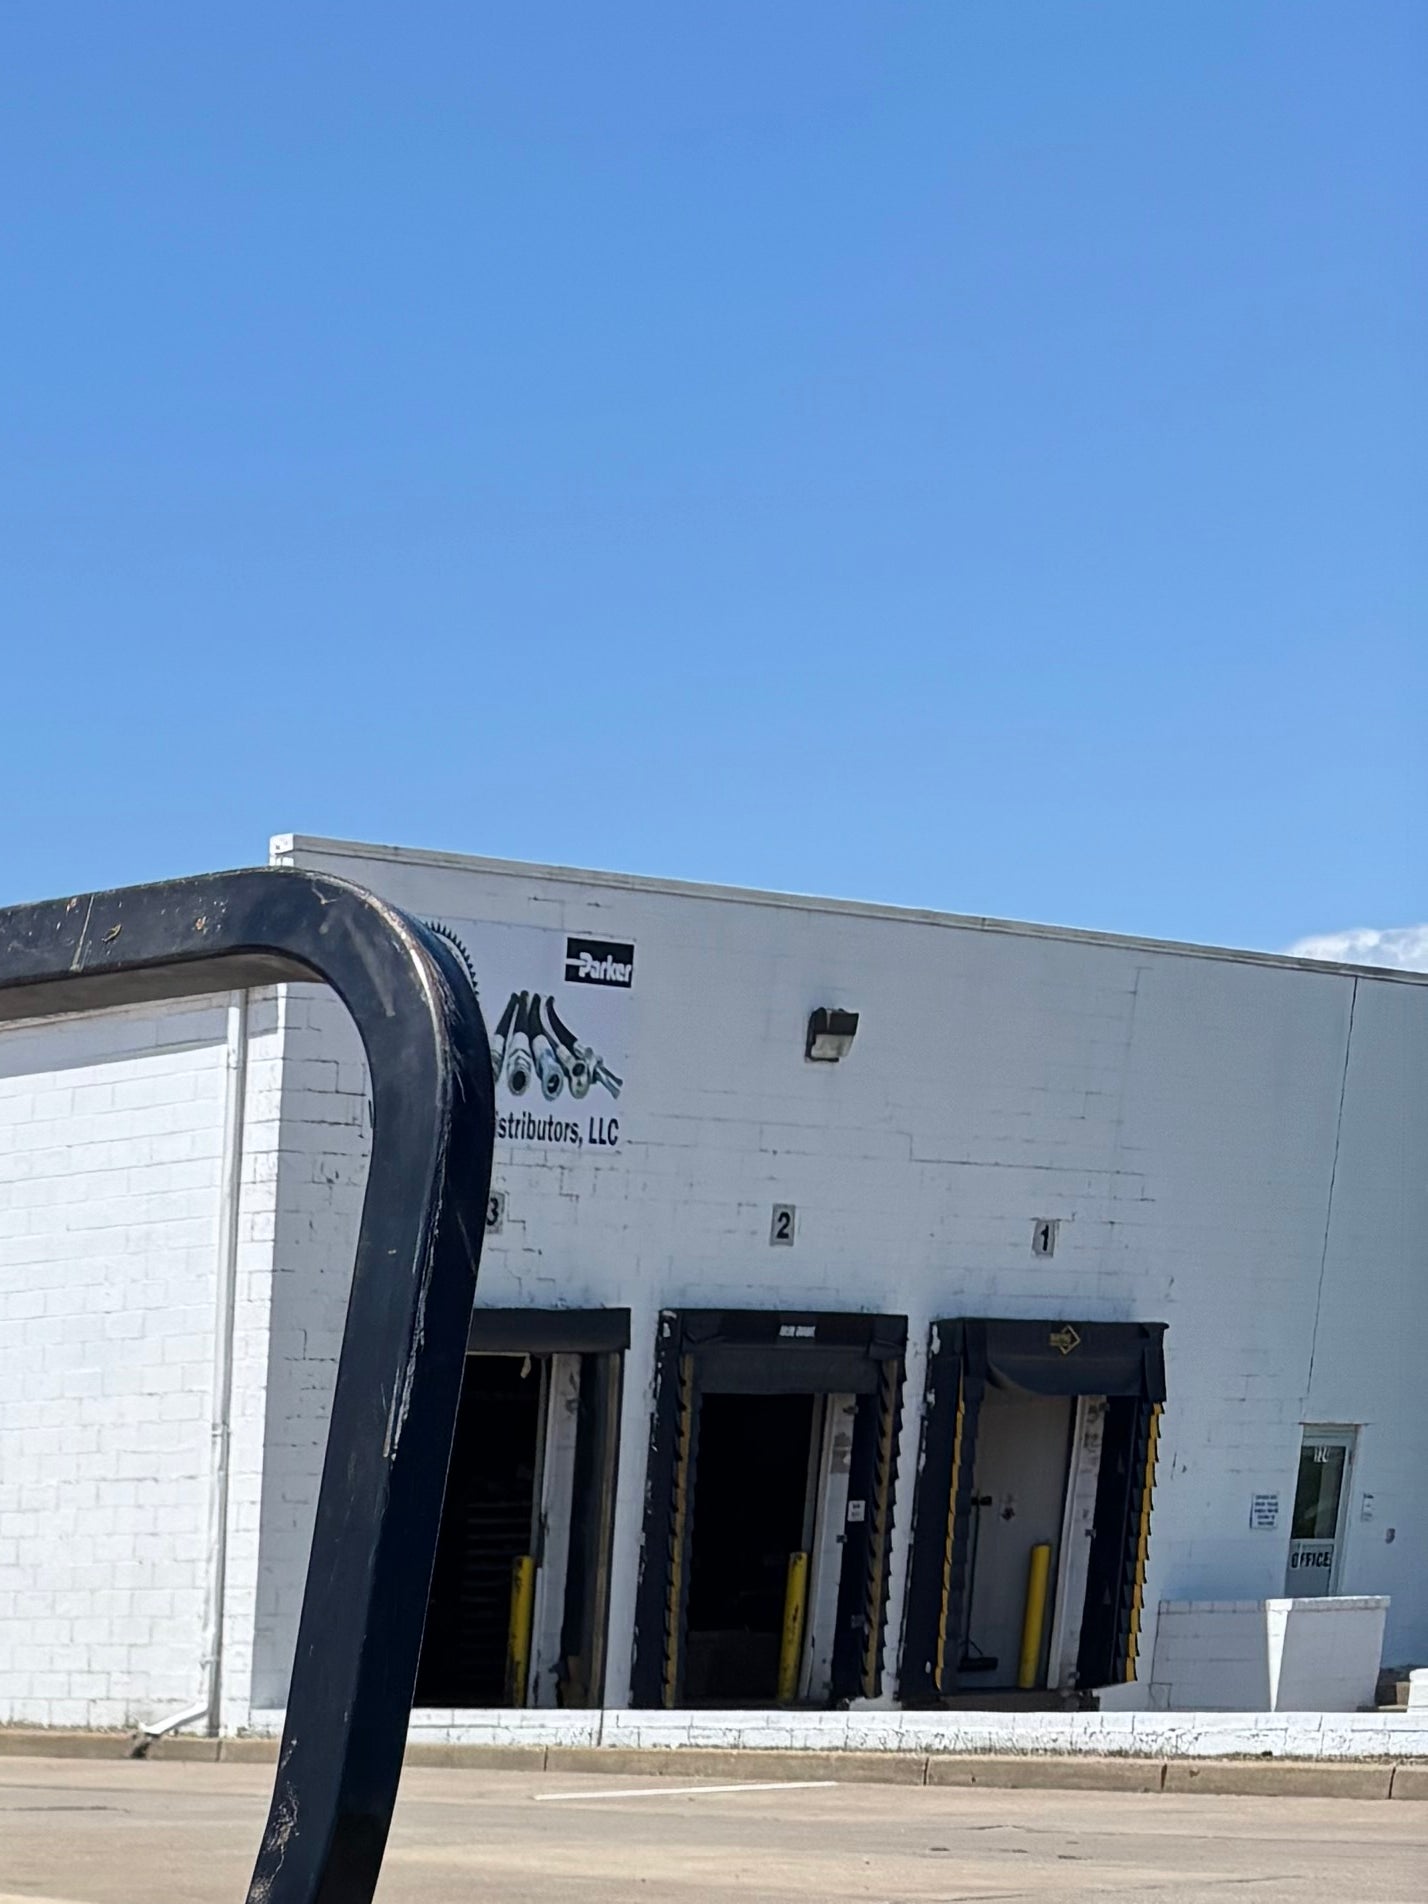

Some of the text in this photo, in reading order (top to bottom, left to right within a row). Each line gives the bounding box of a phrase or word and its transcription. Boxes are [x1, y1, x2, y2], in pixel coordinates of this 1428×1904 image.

[578, 951, 632, 982] Parker
[589, 1117, 620, 1146] LLC
[486, 1197, 499, 1226] 3
[776, 1211, 791, 1239] 2
[1041, 1224, 1049, 1251] 1
[1292, 1552, 1332, 1568] OFFICE
